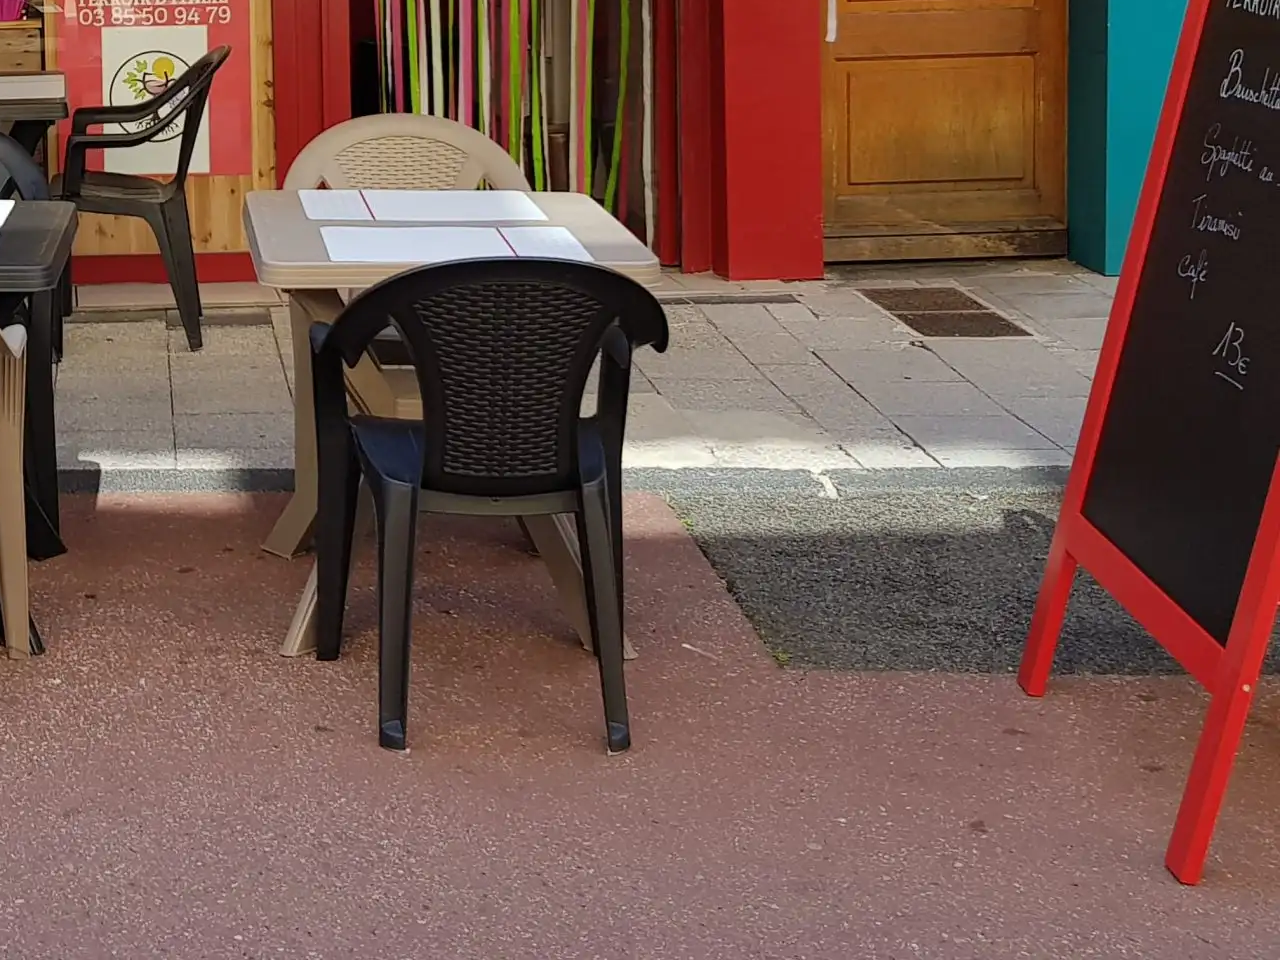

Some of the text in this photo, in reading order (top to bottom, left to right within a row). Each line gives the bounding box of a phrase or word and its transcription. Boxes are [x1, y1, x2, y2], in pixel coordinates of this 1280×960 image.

[79, 6, 231, 26] 03 85 50 94 79
